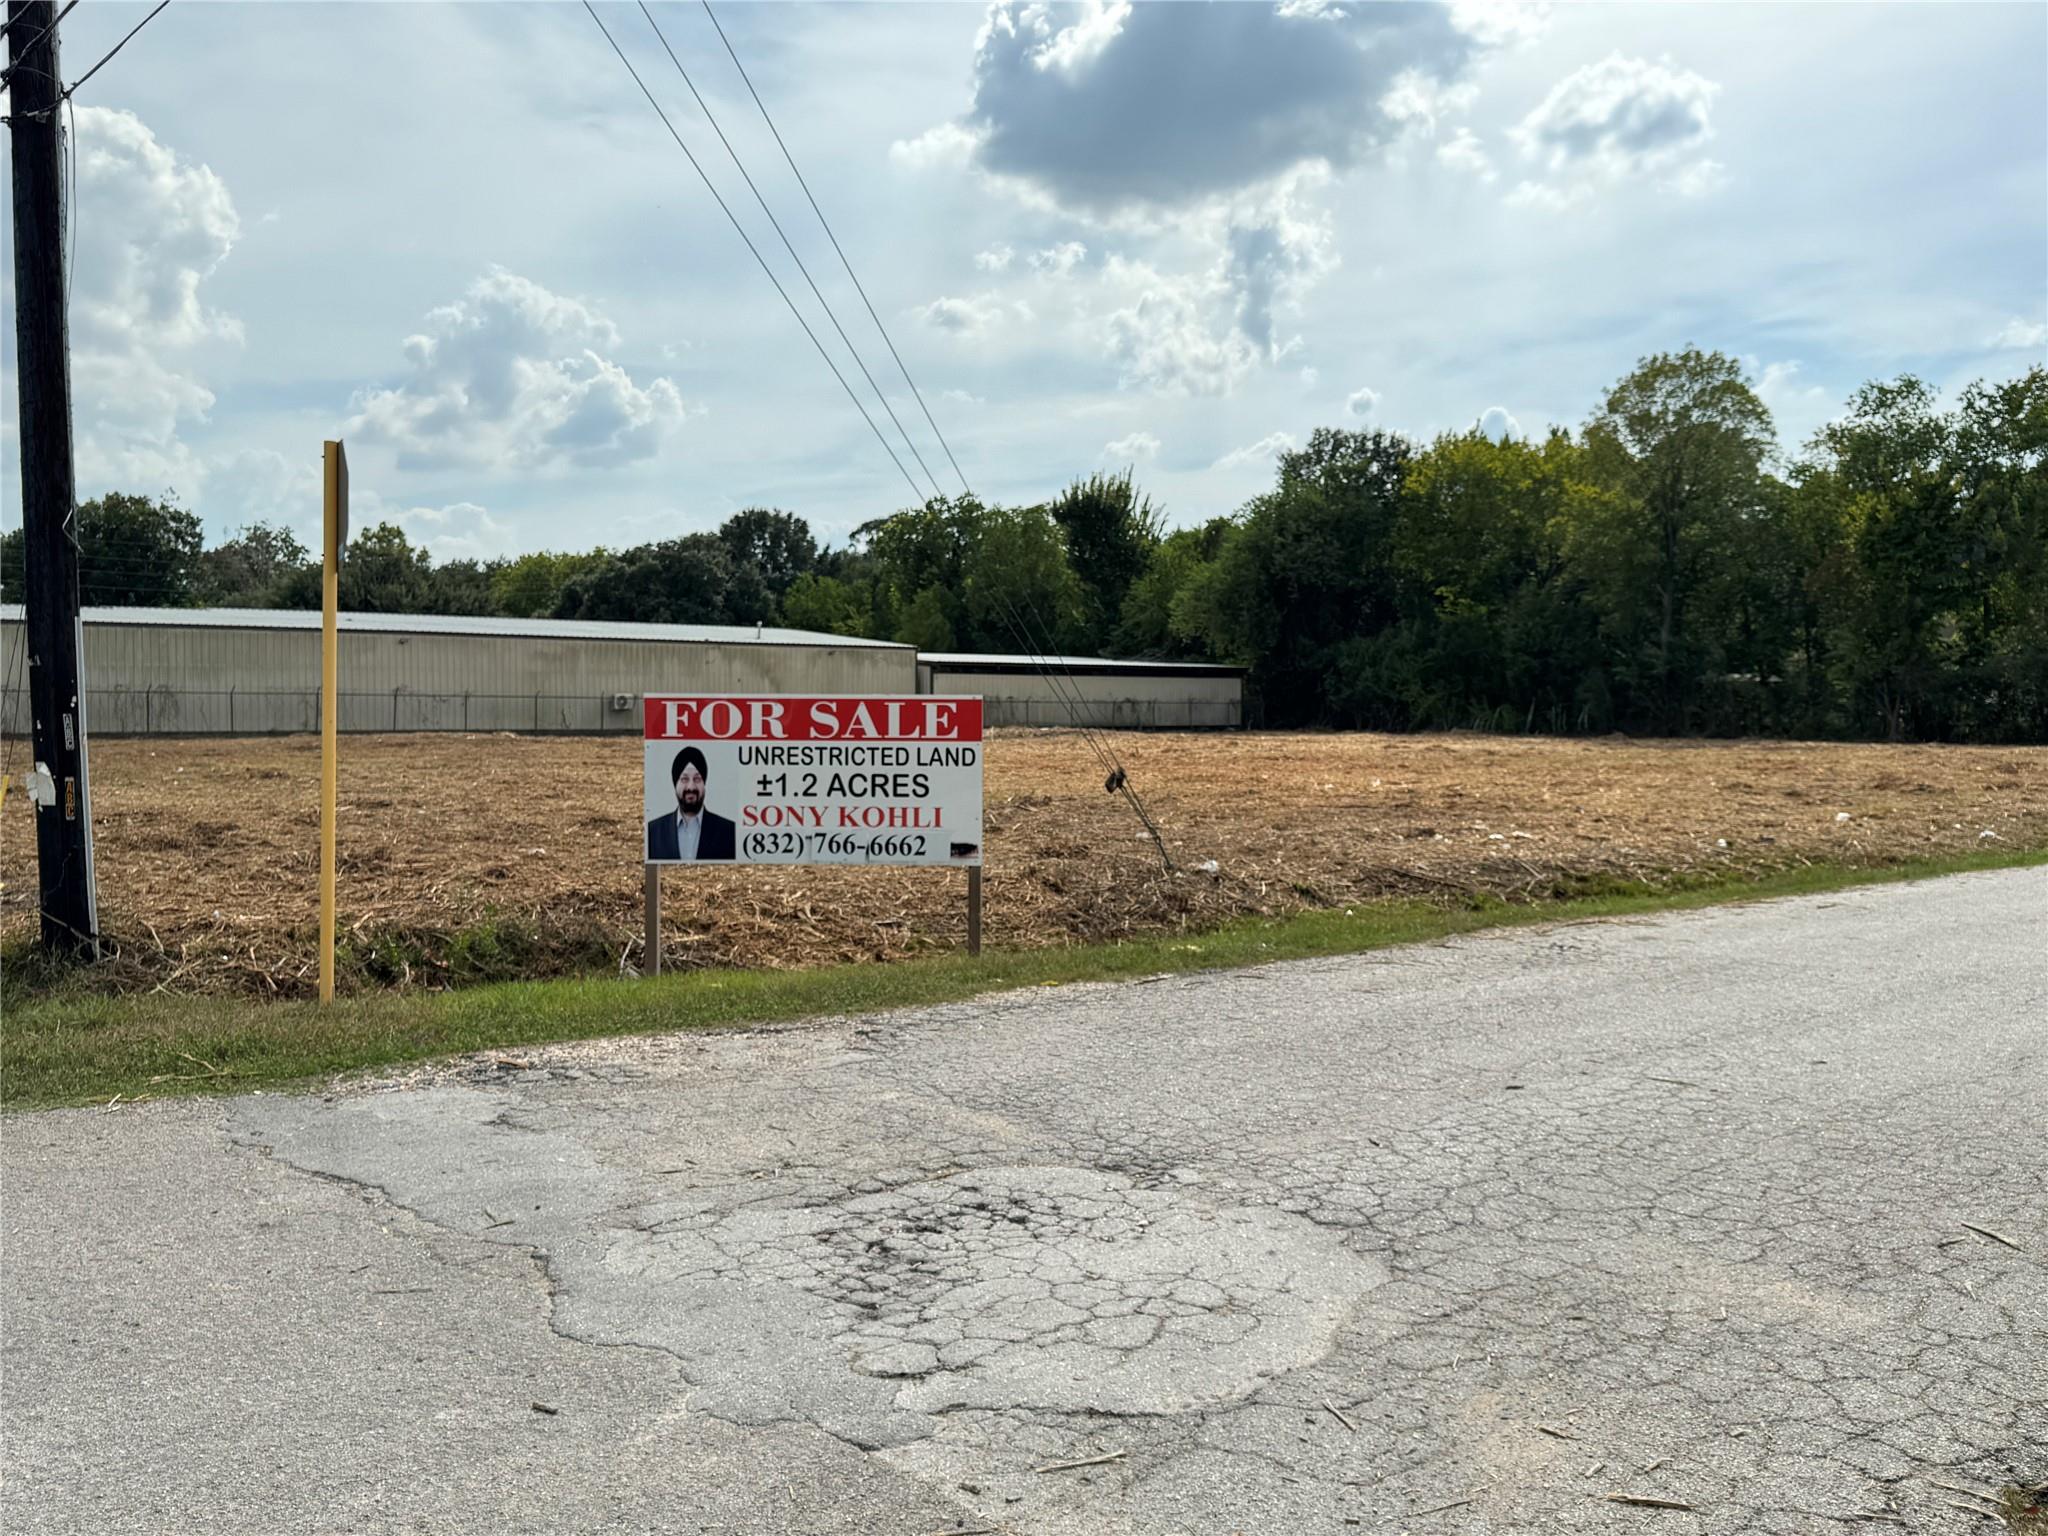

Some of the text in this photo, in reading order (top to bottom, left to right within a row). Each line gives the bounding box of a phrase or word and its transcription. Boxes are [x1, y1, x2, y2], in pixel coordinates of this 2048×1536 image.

[661, 700, 959, 739] FOR SALE
[738, 746, 976, 767] UNRESTRICTED LAND
[757, 773, 930, 798] ±1.2 ACRES
[742, 805, 943, 829] SONY KOHLI
[743, 833, 926, 859] (832) 766-6662
